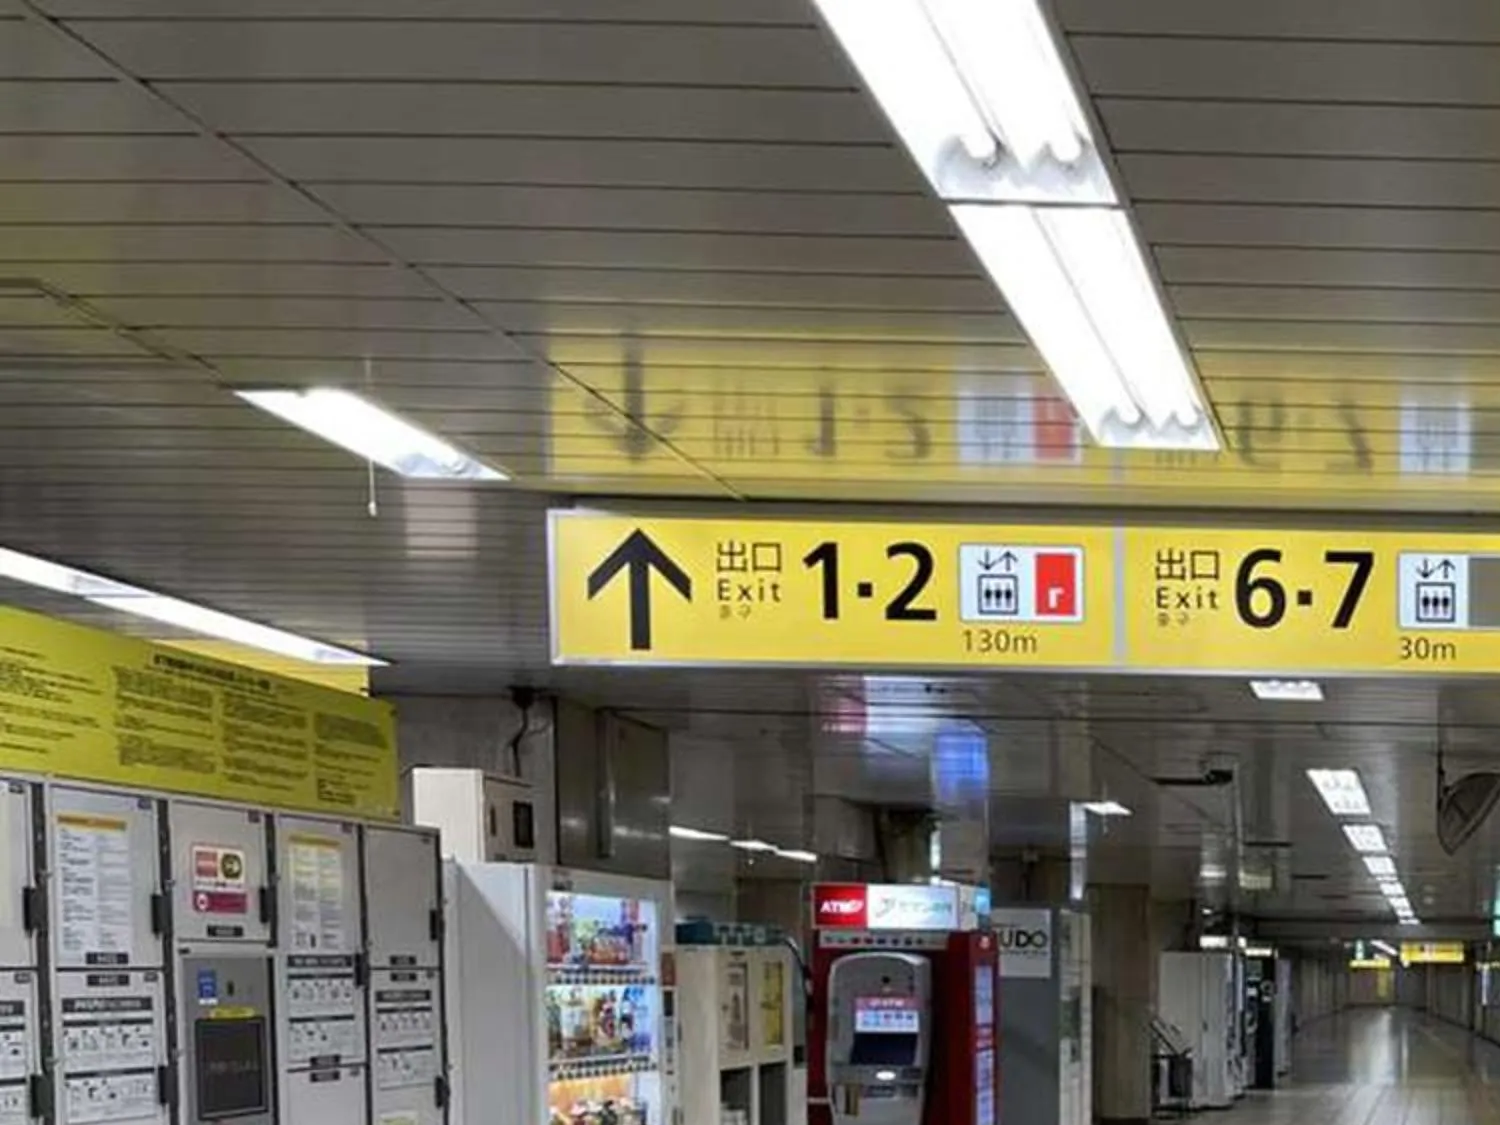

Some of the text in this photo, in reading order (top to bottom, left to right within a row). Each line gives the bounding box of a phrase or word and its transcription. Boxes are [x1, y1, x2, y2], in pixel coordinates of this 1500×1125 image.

[716, 540, 782, 572] 出口
[1155, 548, 1220, 581] 出口
[717, 577, 781, 603] Exit
[1156, 585, 1219, 610] Exit
[963, 629, 1037, 653] 130m
[1400, 637, 1457, 661] 30m
